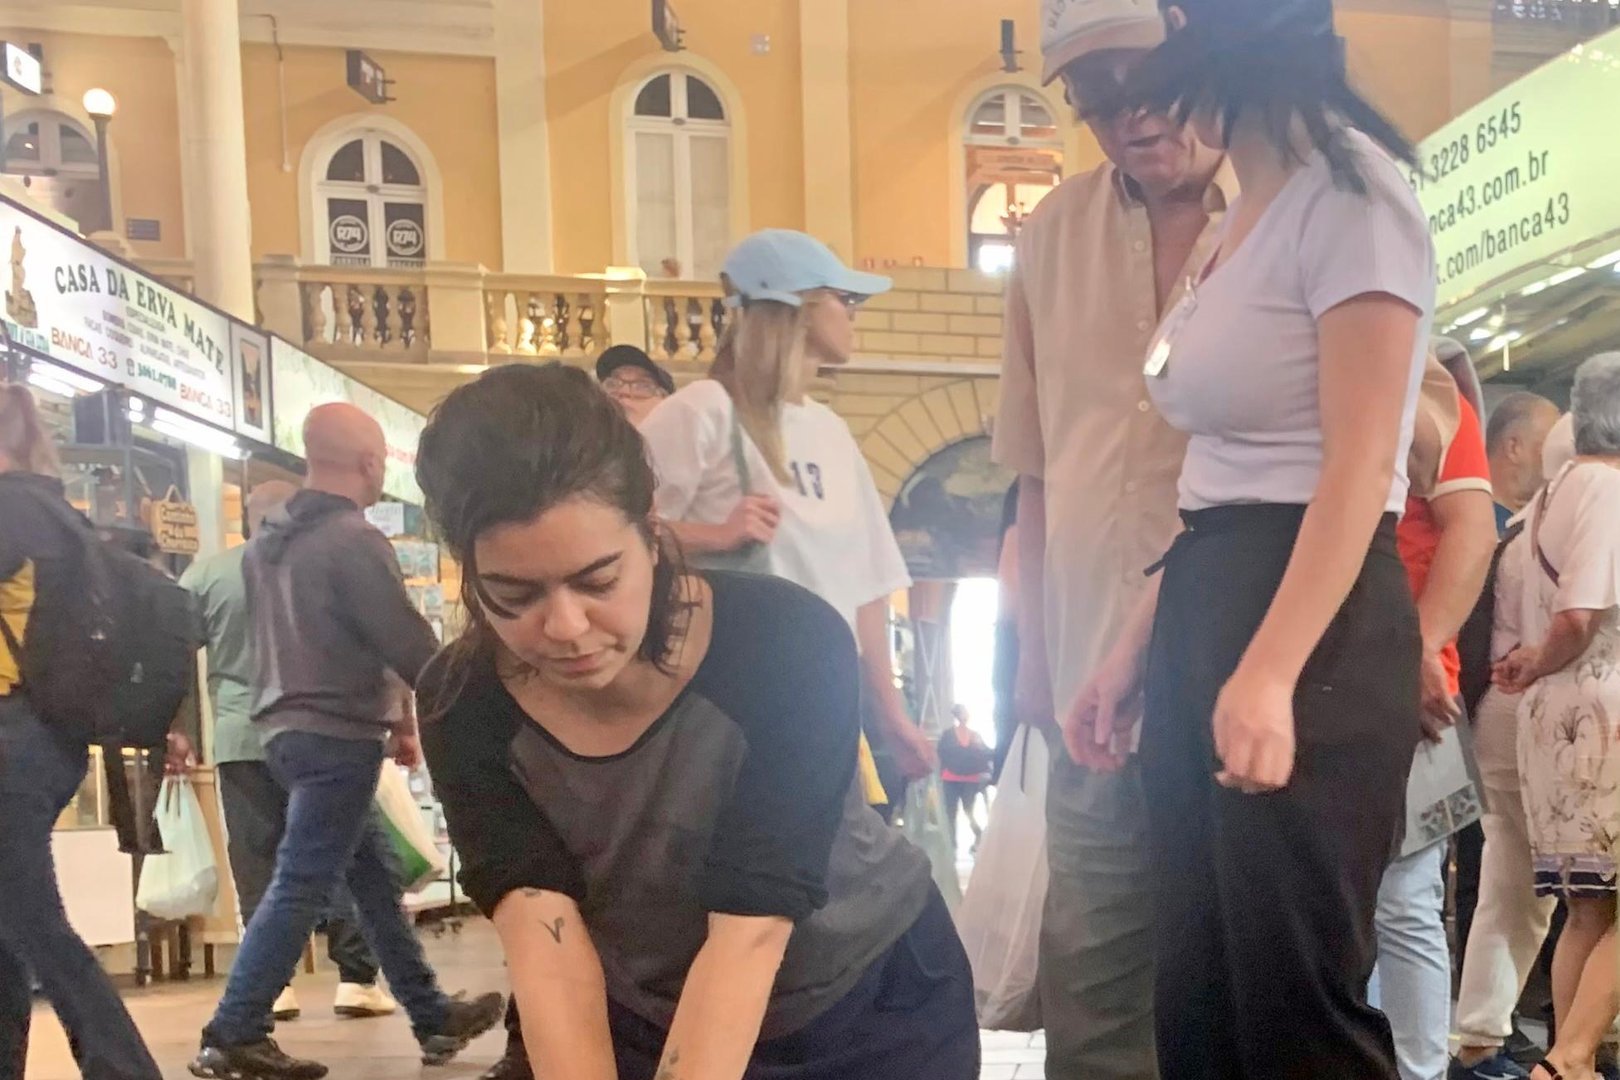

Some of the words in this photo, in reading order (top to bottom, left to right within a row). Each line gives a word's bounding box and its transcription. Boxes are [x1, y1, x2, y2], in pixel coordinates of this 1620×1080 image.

[1431, 134, 1470, 184] 3228
[1476, 101, 1522, 154] 6545
[1429, 150, 1549, 236] nca43.com.br
[1436, 192, 1570, 286] .com/banca43
[51, 326, 93, 359] BANCA
[97, 346, 118, 369] 33
[55, 264, 101, 294] CASA
[105, 268, 130, 302] DA
[135, 280, 178, 329] ERVA
[183, 312, 225, 376] MATE
[180, 383, 214, 409] BANCA
[216, 398, 232, 418] 33
